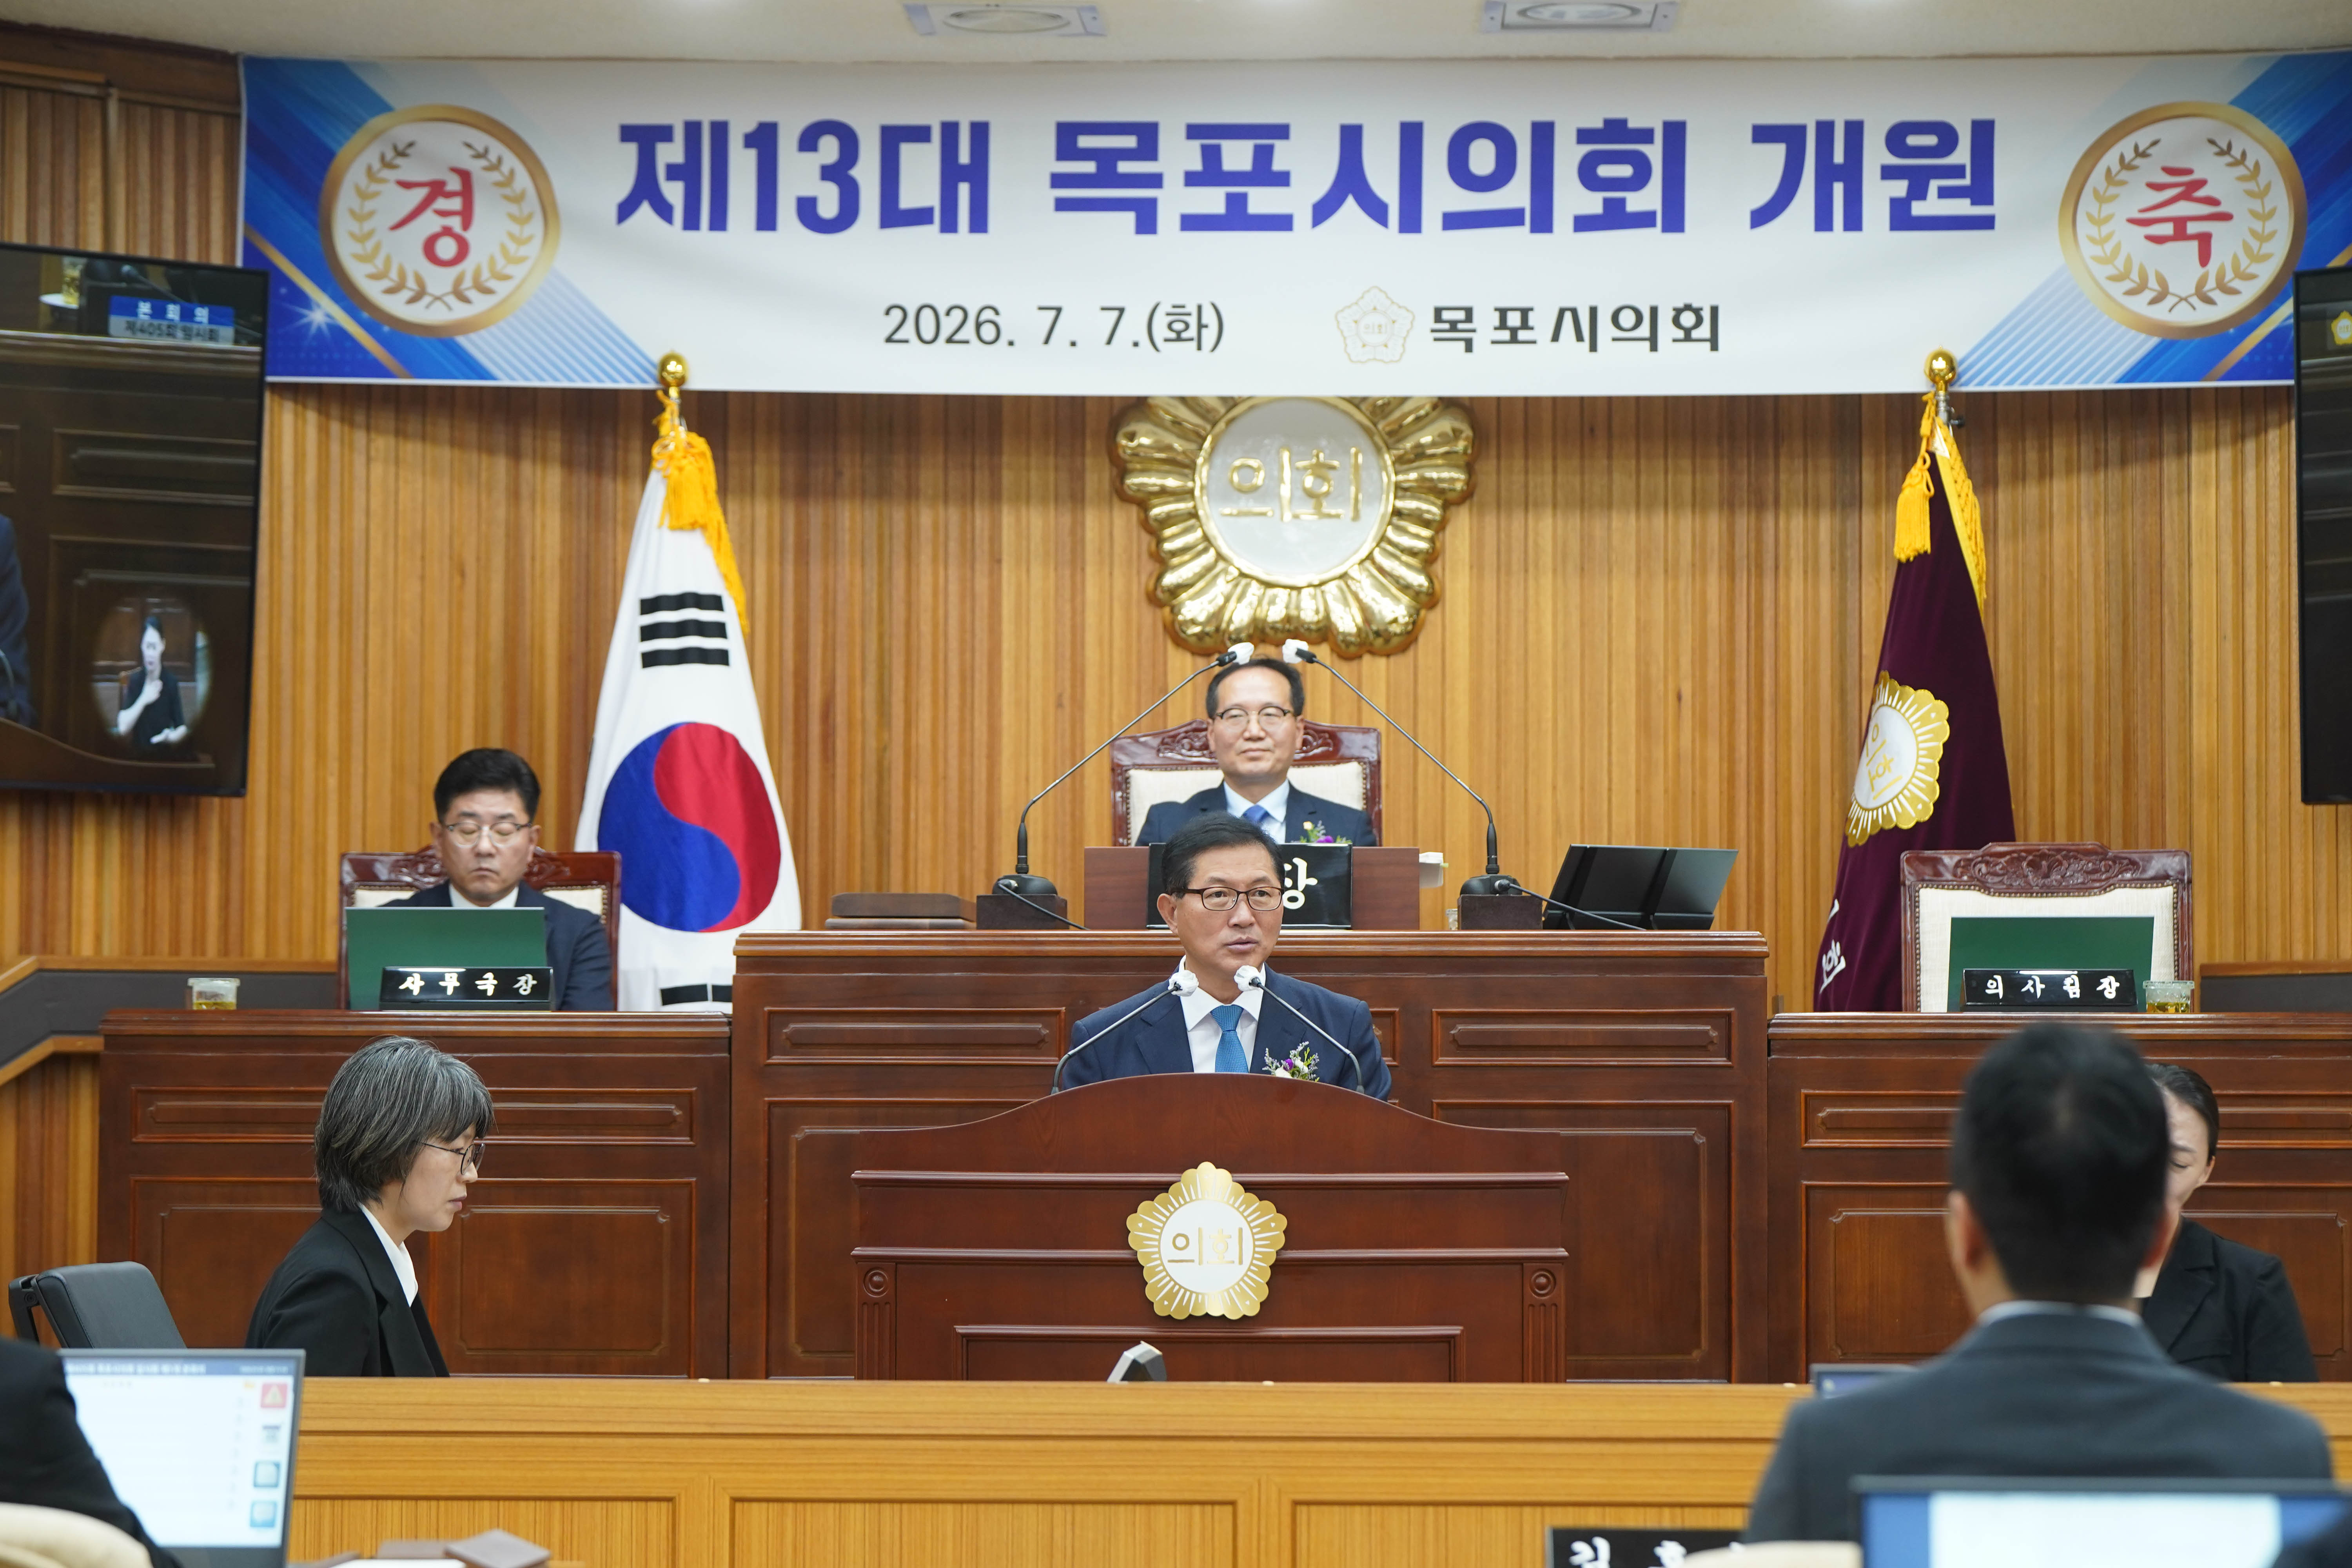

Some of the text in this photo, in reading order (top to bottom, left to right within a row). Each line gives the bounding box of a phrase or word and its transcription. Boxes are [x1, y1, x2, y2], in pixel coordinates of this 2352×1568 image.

[616, 118, 1996, 235] 제13대 목포시의회 개원
[388, 166, 474, 268] 경
[2125, 165, 2234, 268] 축
[884, 304, 1015, 347] 2026.
[1430, 303, 1719, 353] 목포시의회
[1219, 446, 1363, 523] 의회
[1167, 1227, 1243, 1266] 의회
